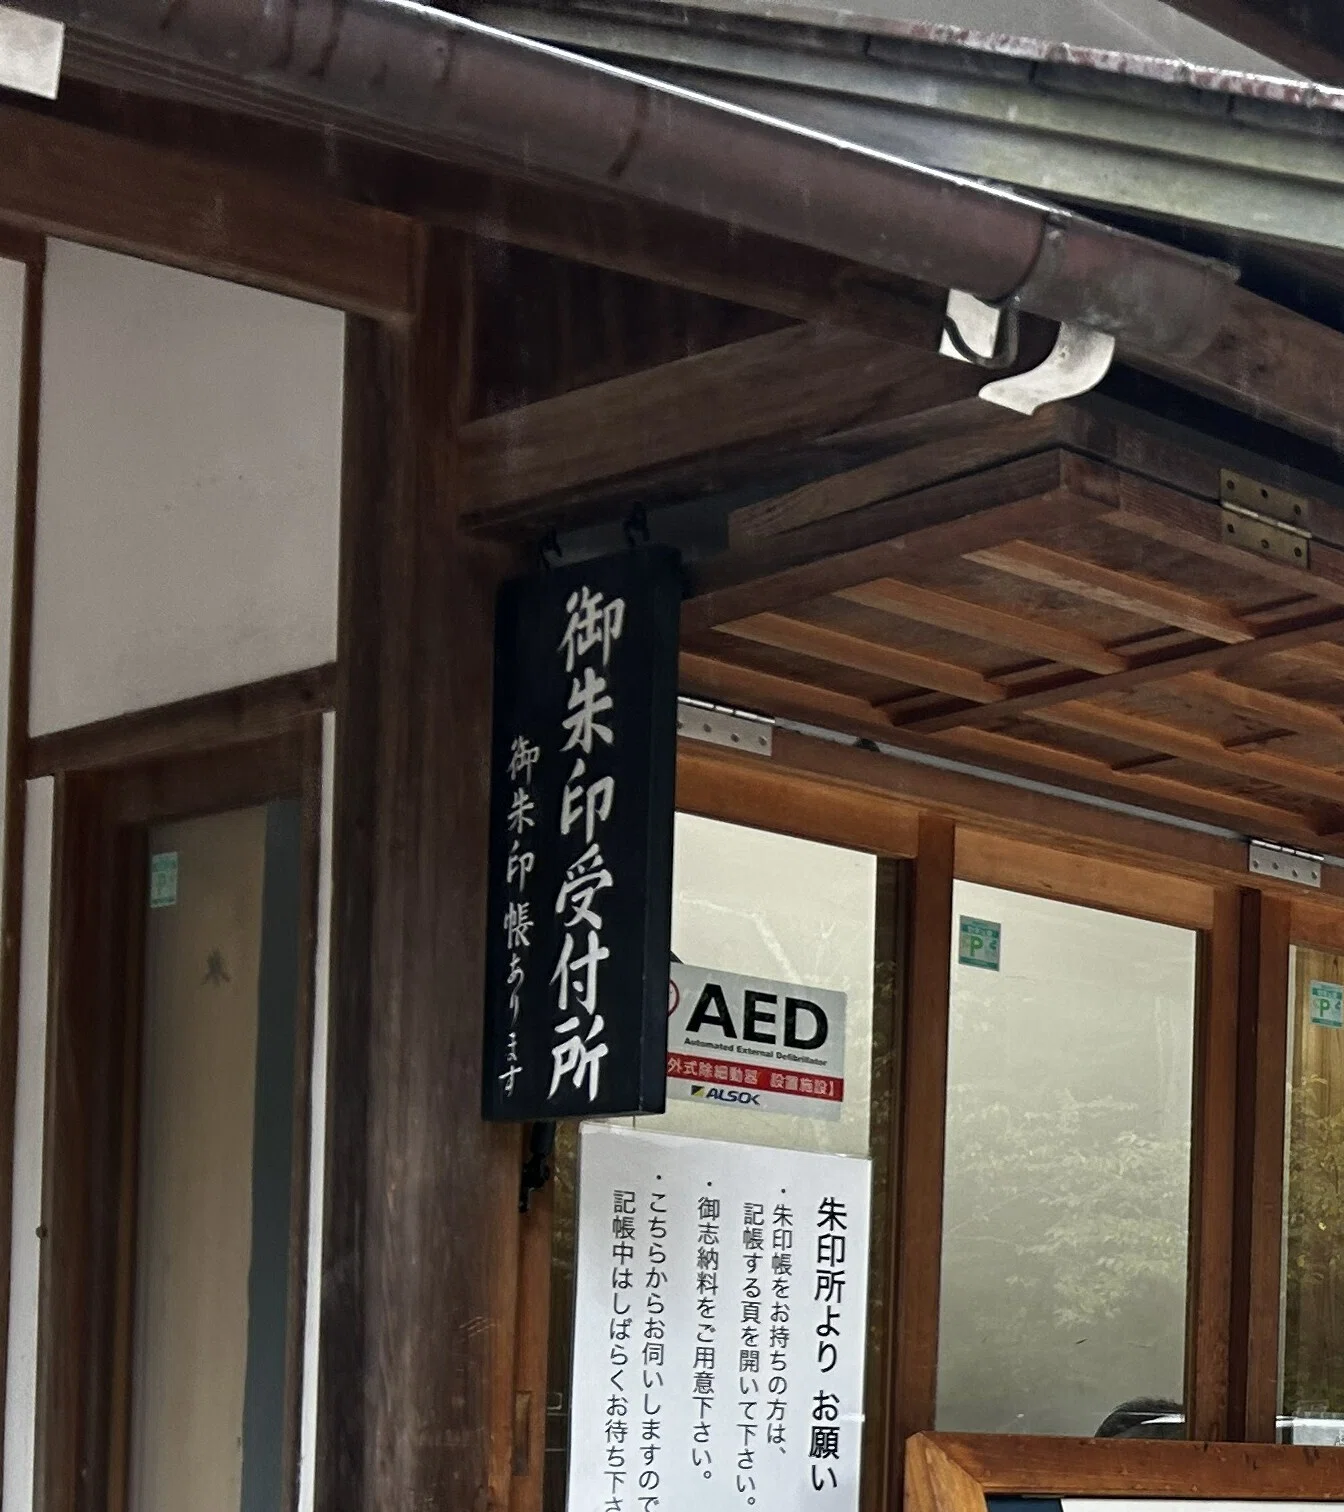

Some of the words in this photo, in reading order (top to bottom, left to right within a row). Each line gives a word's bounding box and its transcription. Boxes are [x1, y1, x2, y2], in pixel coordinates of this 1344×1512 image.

[547, 585, 625, 1101] 御朱印受付所
[499, 735, 542, 1097] 御朱印帳あります
[684, 1037, 734, 1052] Automated
[736, 1045, 774, 1058] External
[776, 1051, 828, 1067] Defibrillator
[685, 982, 829, 1050] AED
[706, 1087, 761, 1105] ALSOK
[736, 1202, 765, 1507] 記帳する頁を開いて下さい。
[814, 1197, 848, 1374] 朱印所より
[809, 1390, 841, 1492] お願い
